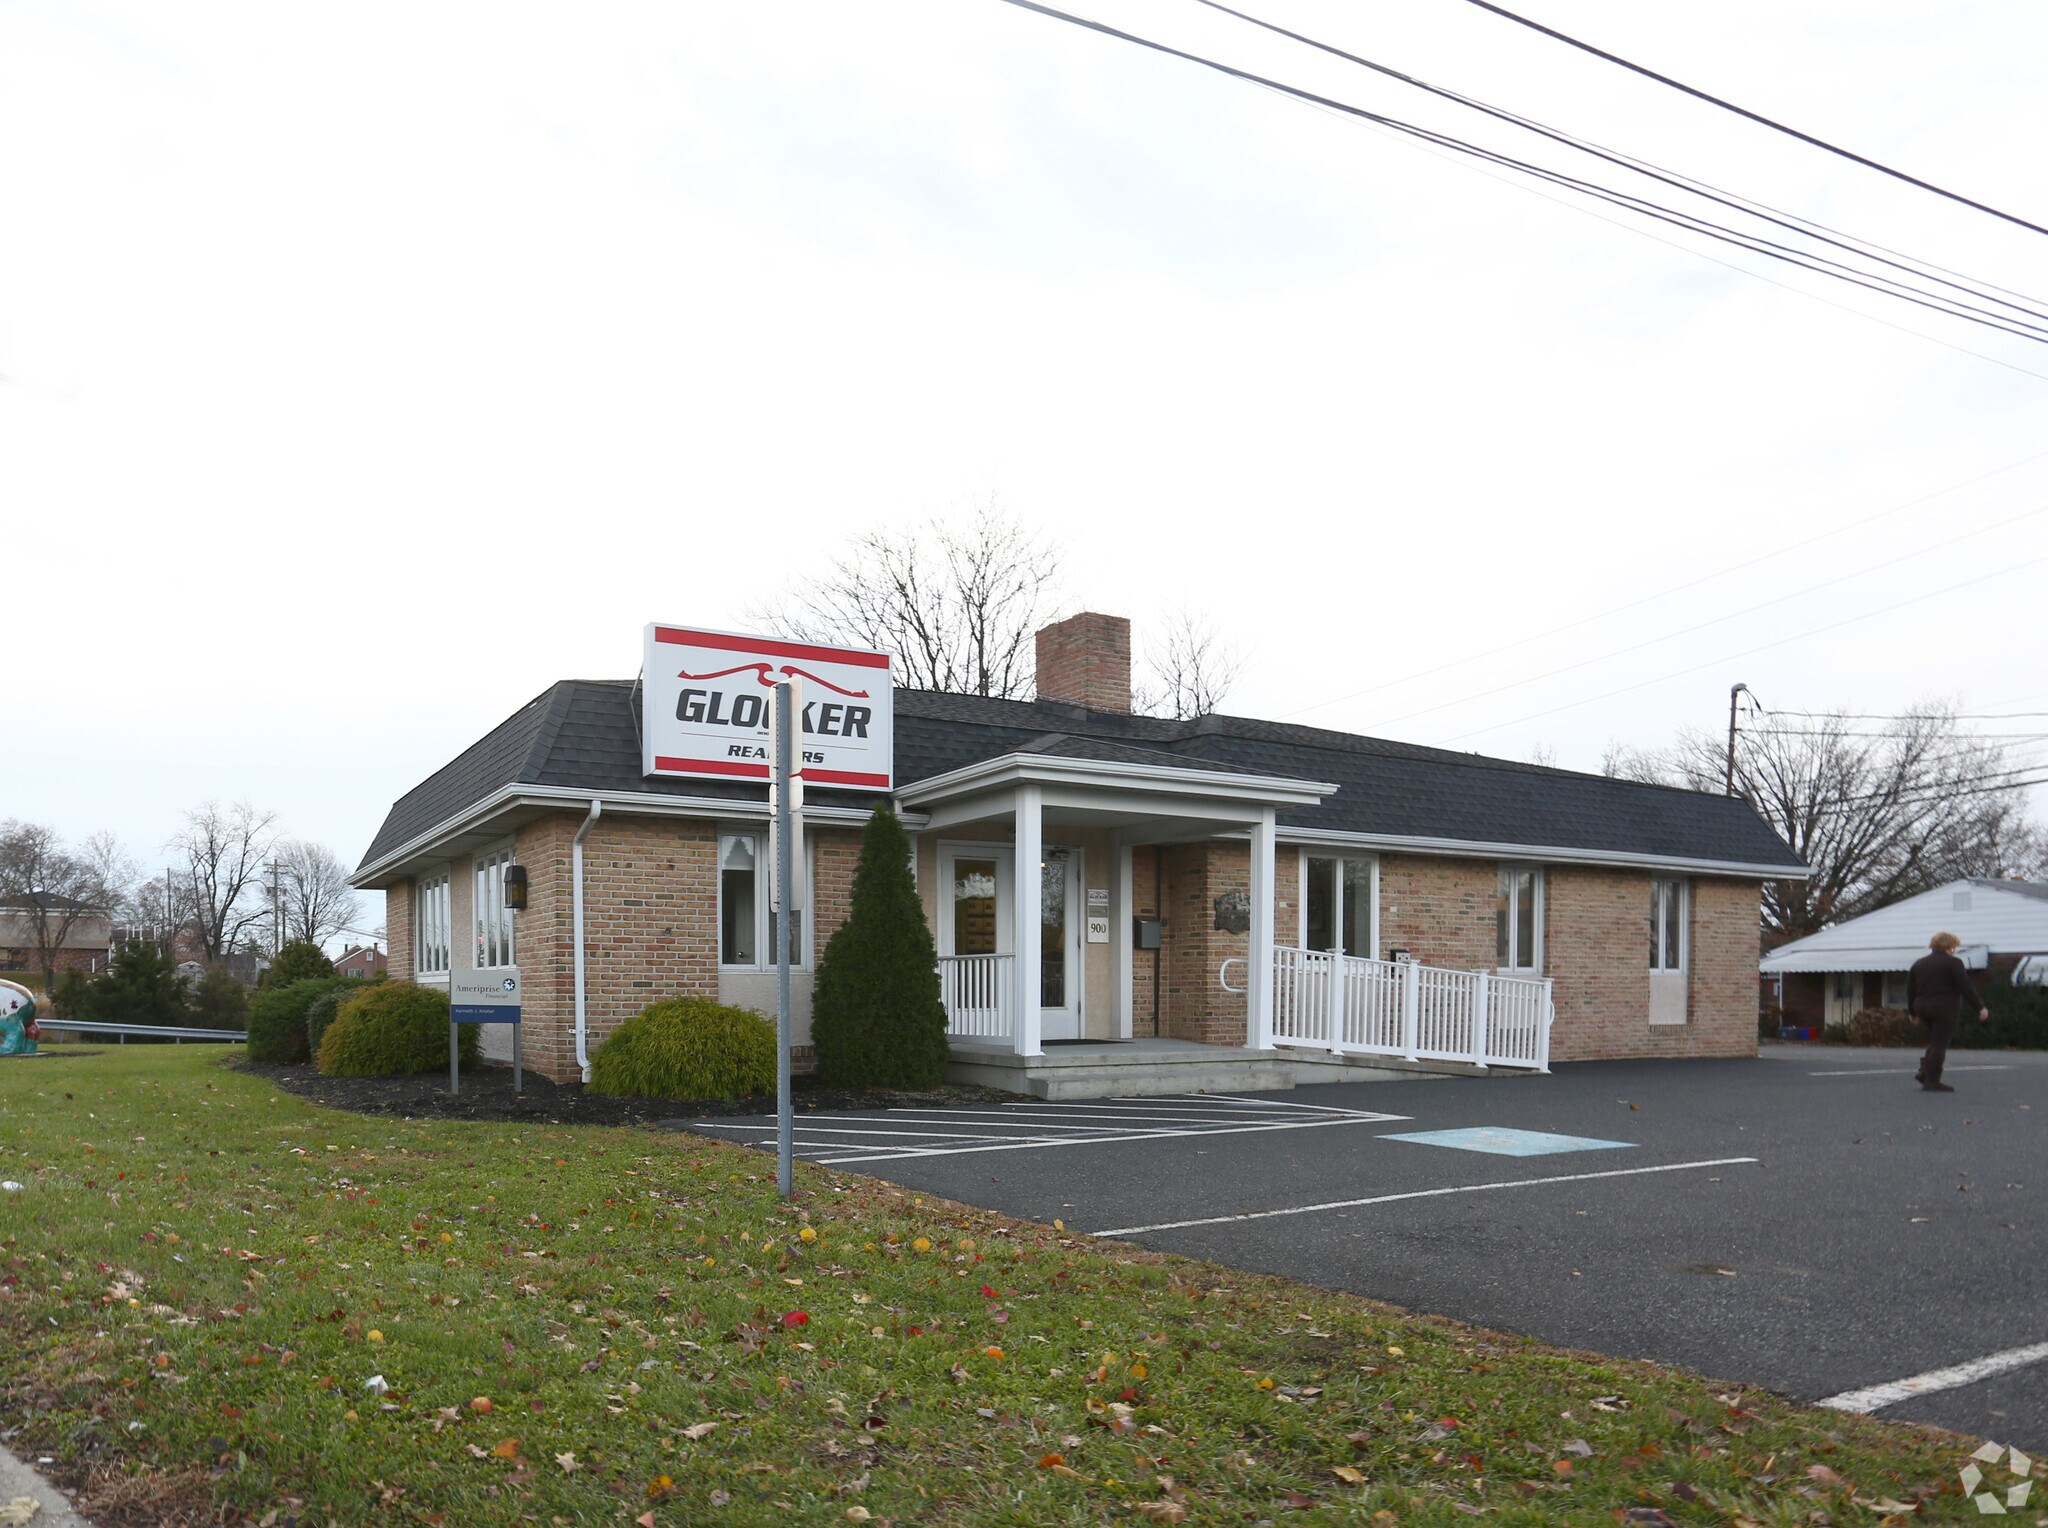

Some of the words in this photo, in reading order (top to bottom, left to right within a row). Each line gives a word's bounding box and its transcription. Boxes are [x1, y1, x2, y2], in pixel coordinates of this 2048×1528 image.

[676, 688, 872, 739] GLOKER
[727, 745, 825, 764] REARS
[1091, 923, 1106, 933] 900
[455, 985, 500, 994] Ameriprise
